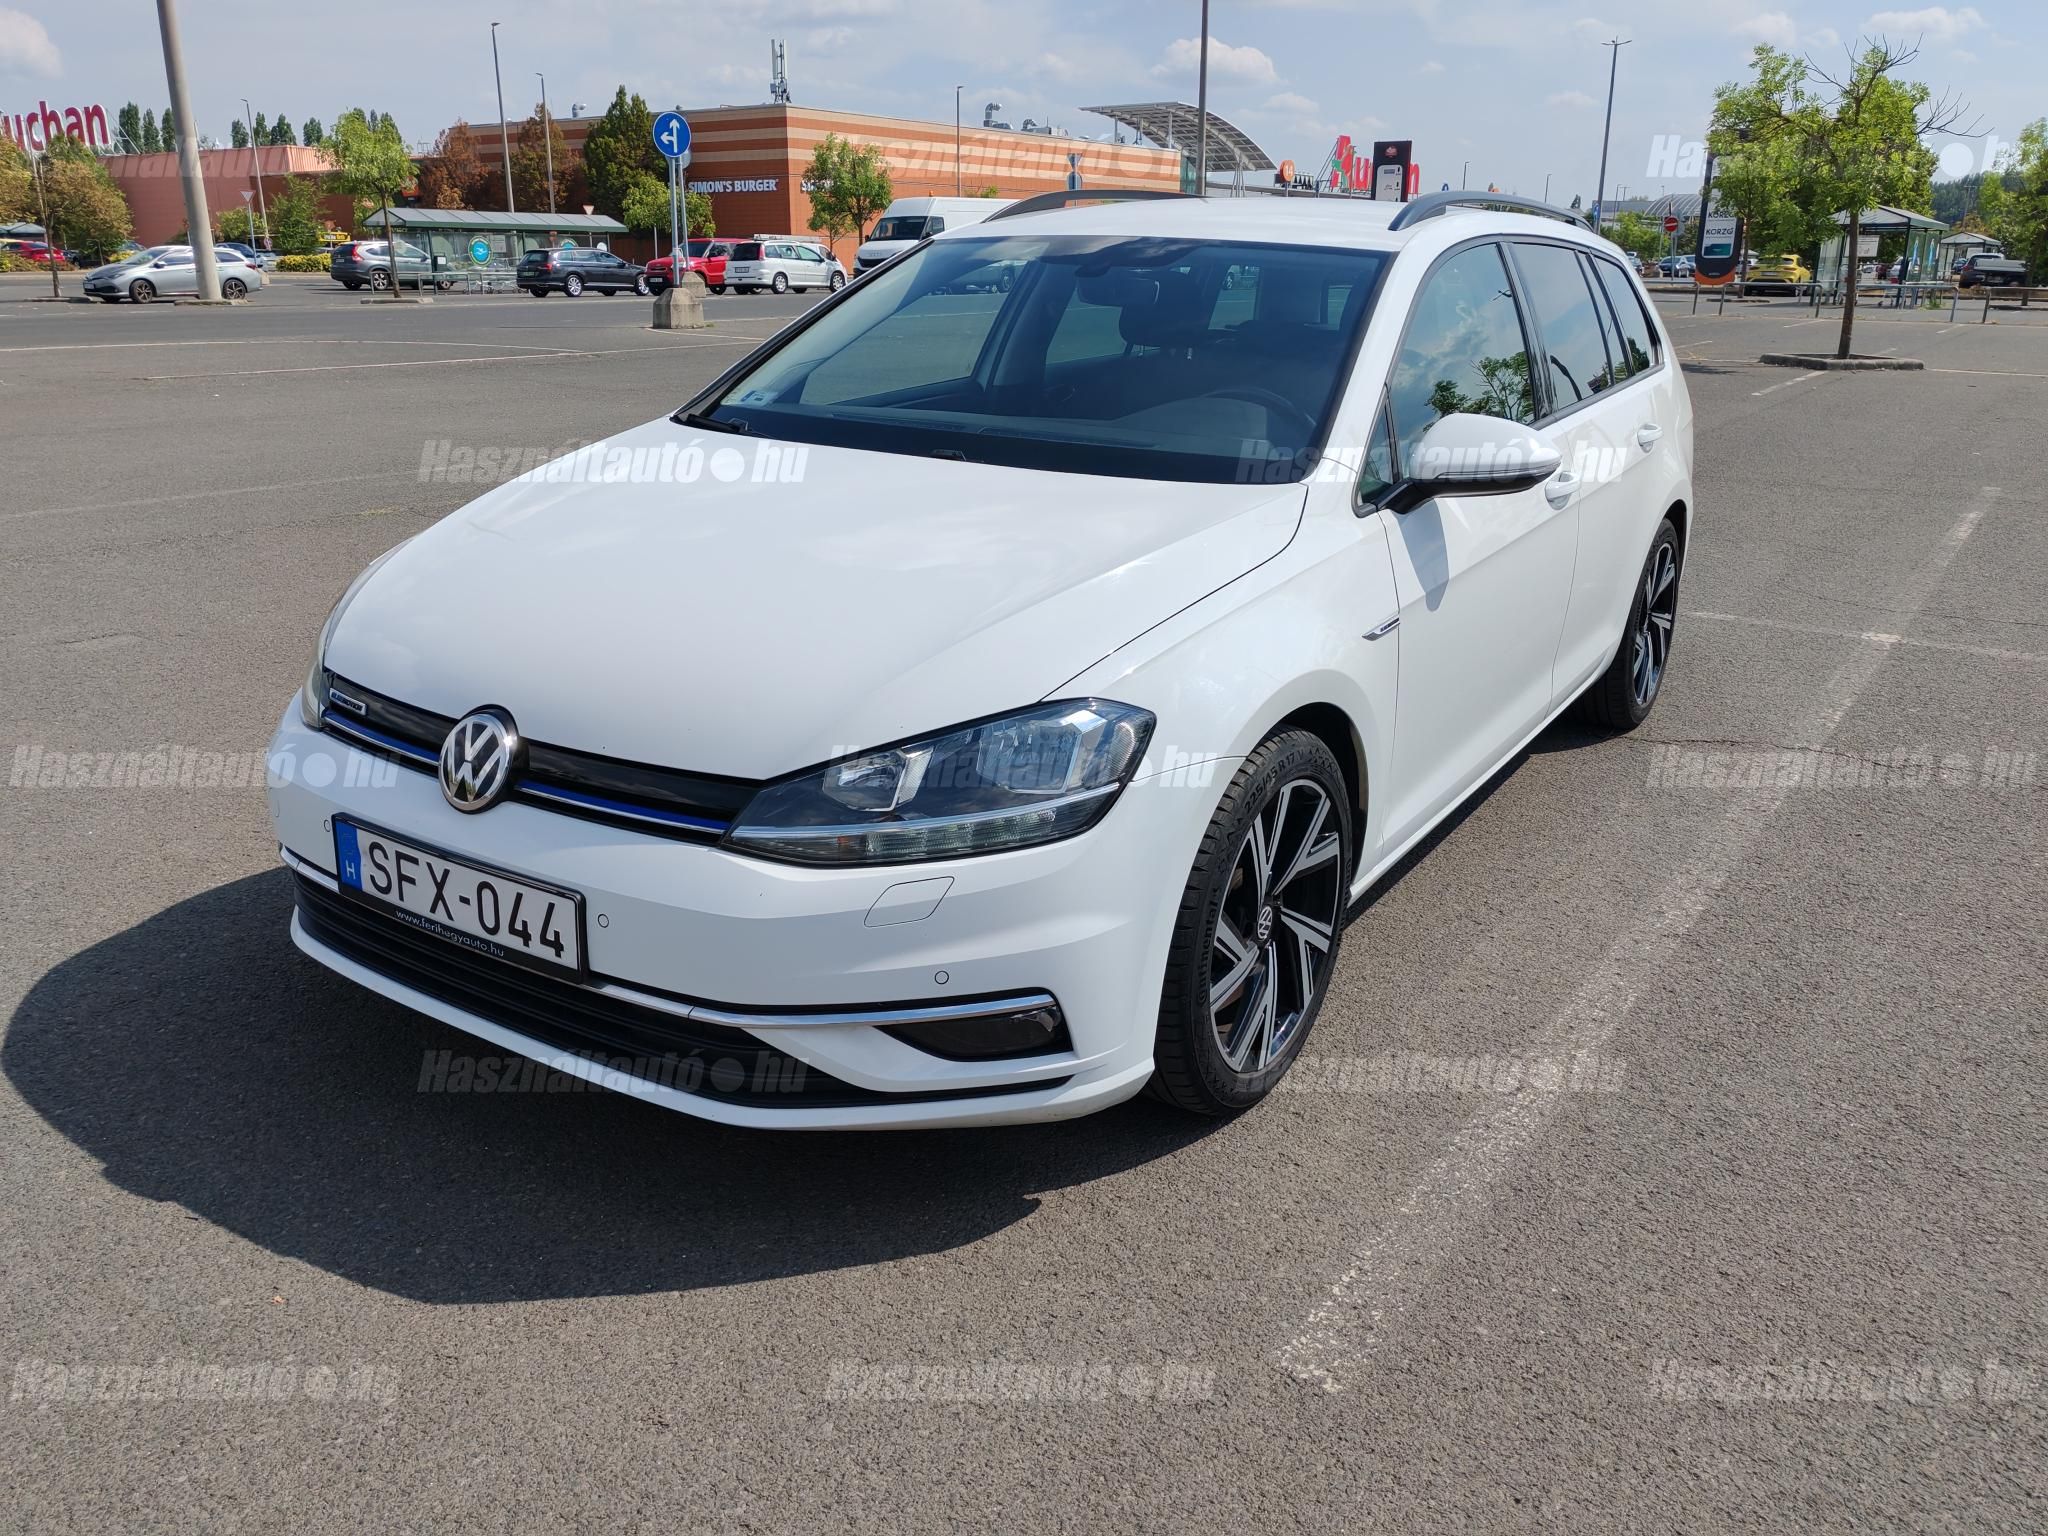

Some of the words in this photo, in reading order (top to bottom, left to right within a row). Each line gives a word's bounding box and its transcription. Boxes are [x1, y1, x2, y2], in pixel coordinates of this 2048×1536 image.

[2, 101, 110, 151] uchan
[688, 180, 732, 193] SIMON'S
[734, 179, 777, 192] BURGER
[346, 859, 356, 881] H
[368, 841, 565, 959] SFX-044
[395, 910, 504, 957] www.ferihegyauto.hu
